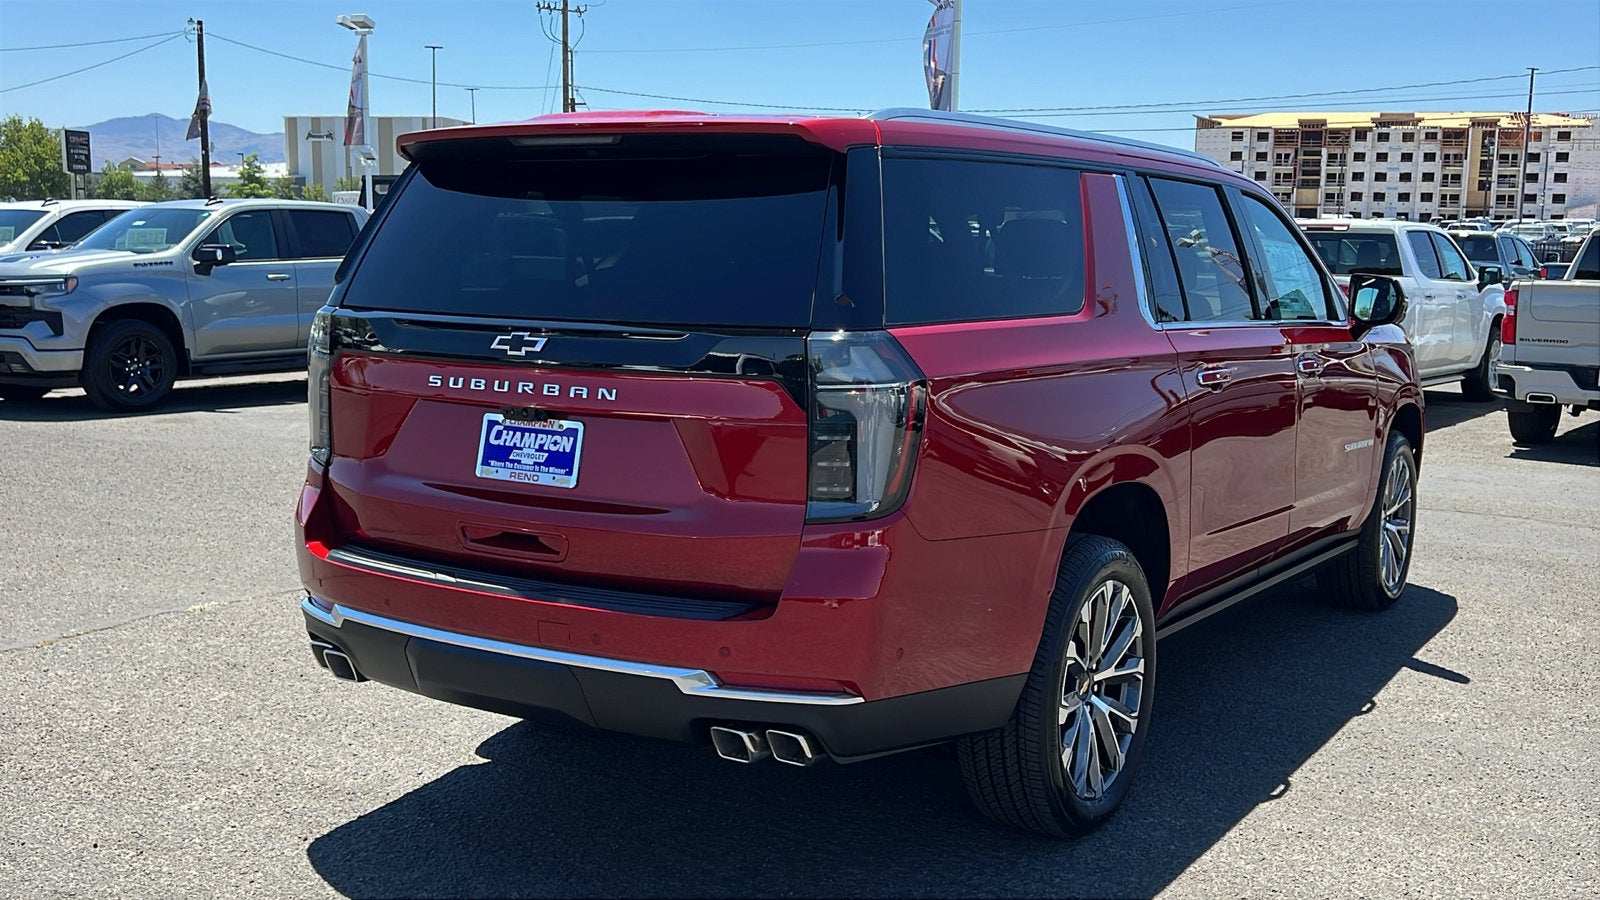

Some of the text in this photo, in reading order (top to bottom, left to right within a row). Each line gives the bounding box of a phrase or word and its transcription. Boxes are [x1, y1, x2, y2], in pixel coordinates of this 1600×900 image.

[428, 375, 617, 401] SUBURBAN
[489, 425, 574, 452] CHAMPION
[512, 451, 545, 460] CHEVROLET
[505, 461, 513, 469] The
[513, 462, 535, 471] Customer
[540, 465, 549, 473] The
[509, 471, 540, 482] RENO
